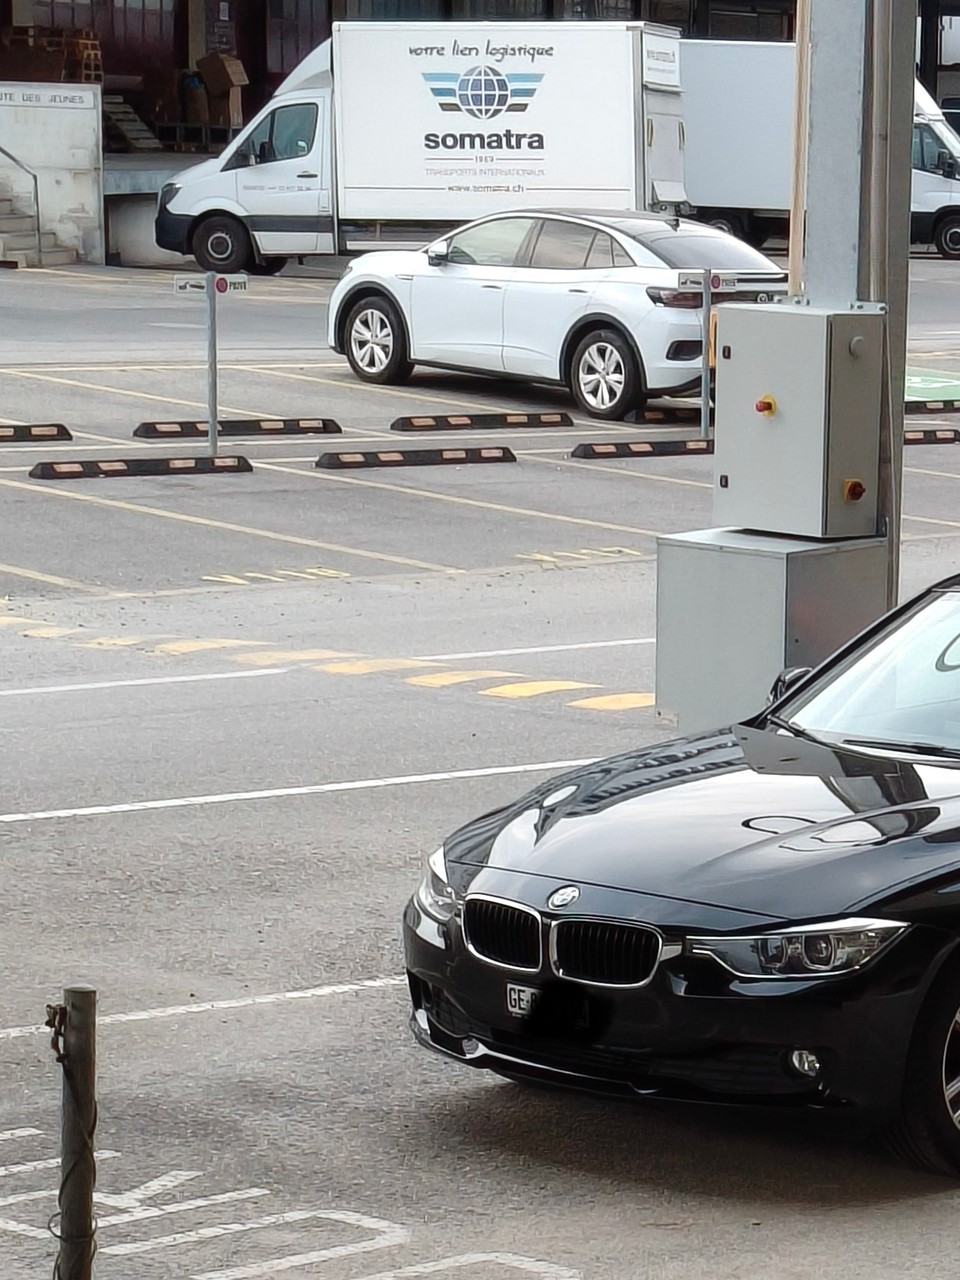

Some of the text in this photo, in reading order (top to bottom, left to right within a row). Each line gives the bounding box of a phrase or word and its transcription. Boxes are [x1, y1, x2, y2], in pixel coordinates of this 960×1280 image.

[452, 39, 479, 56] lien
[485, 39, 554, 63] logistique
[22, 92, 41, 102] DES
[424, 129, 545, 150] somatra
